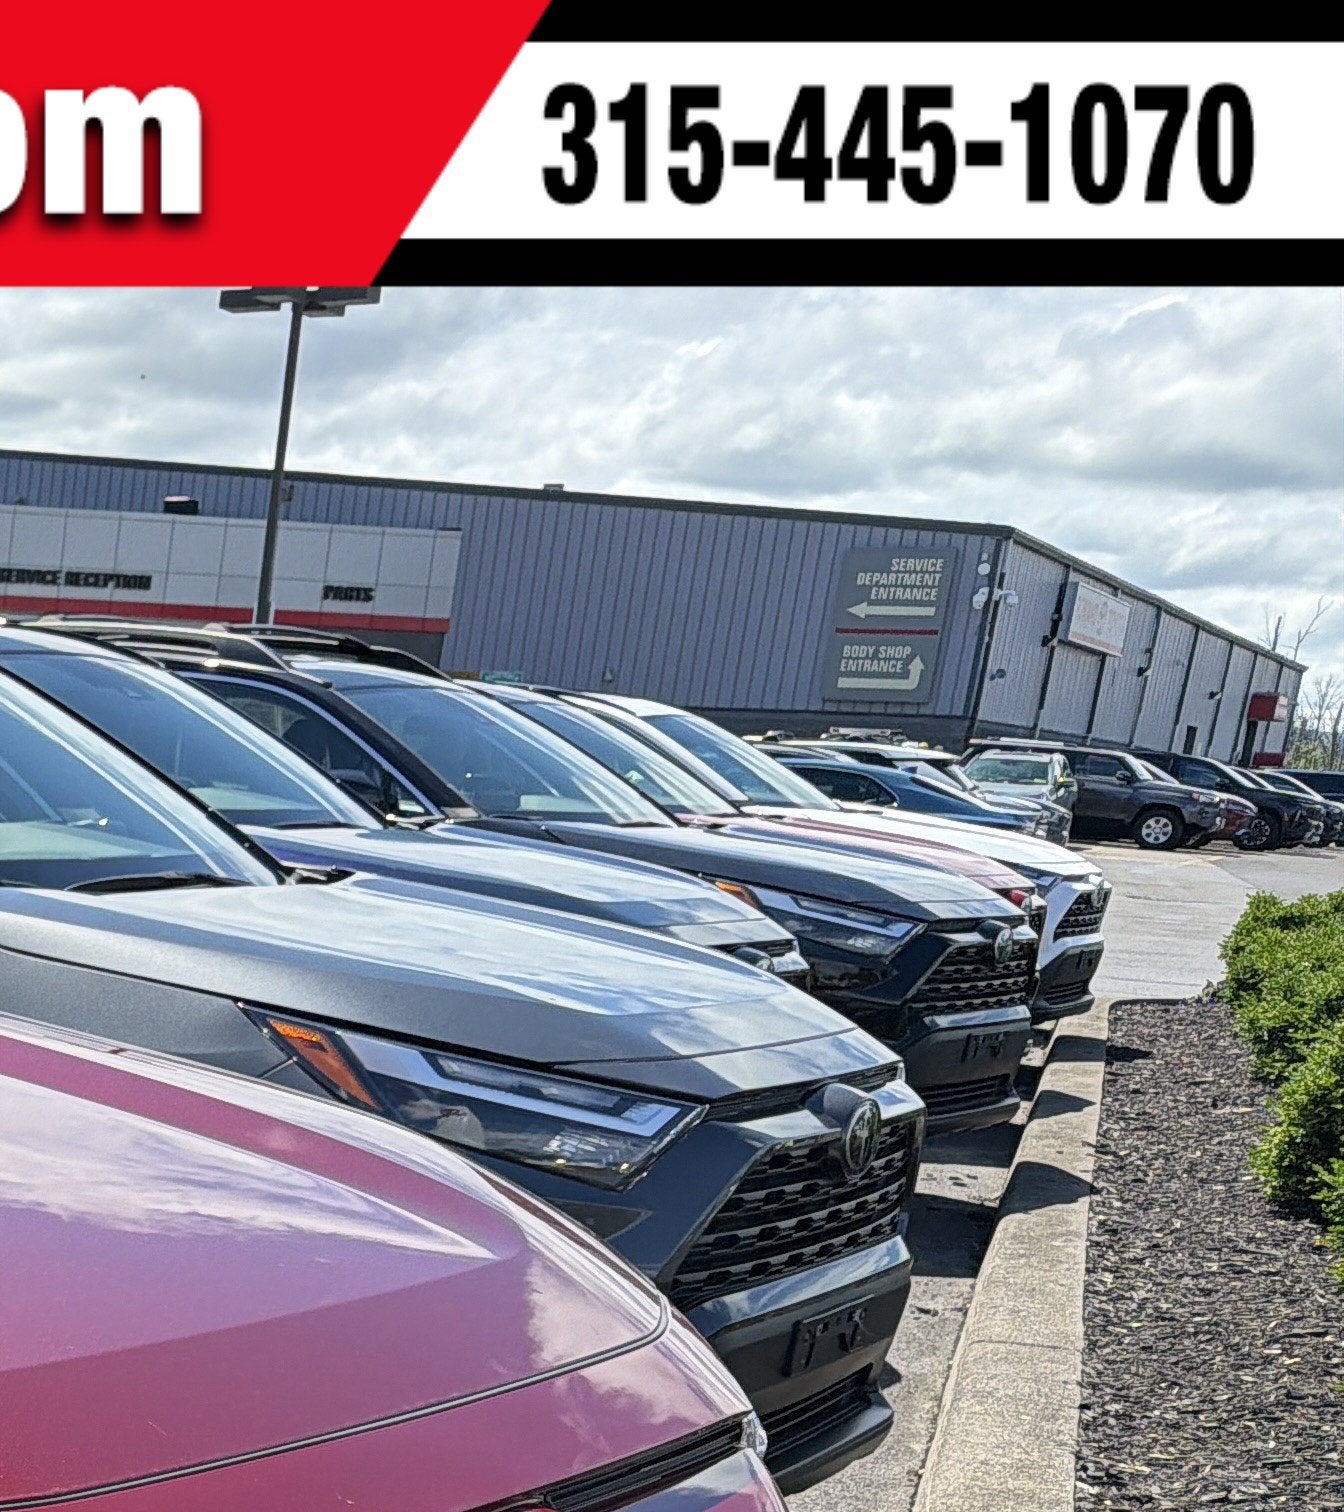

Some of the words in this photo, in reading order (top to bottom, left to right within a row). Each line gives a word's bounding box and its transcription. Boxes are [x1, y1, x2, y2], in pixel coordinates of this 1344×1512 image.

[890, 558, 945, 572] SERVICE
[63, 571, 153, 591] RECEPTION
[856, 572, 943, 587] DEPARTMENT
[323, 585, 375, 602] PARTS
[870, 586, 939, 601] ENTRANCE
[842, 645, 877, 659] BODY
[878, 645, 912, 660] SHOP
[839, 658, 904, 673] ENTRANCE
